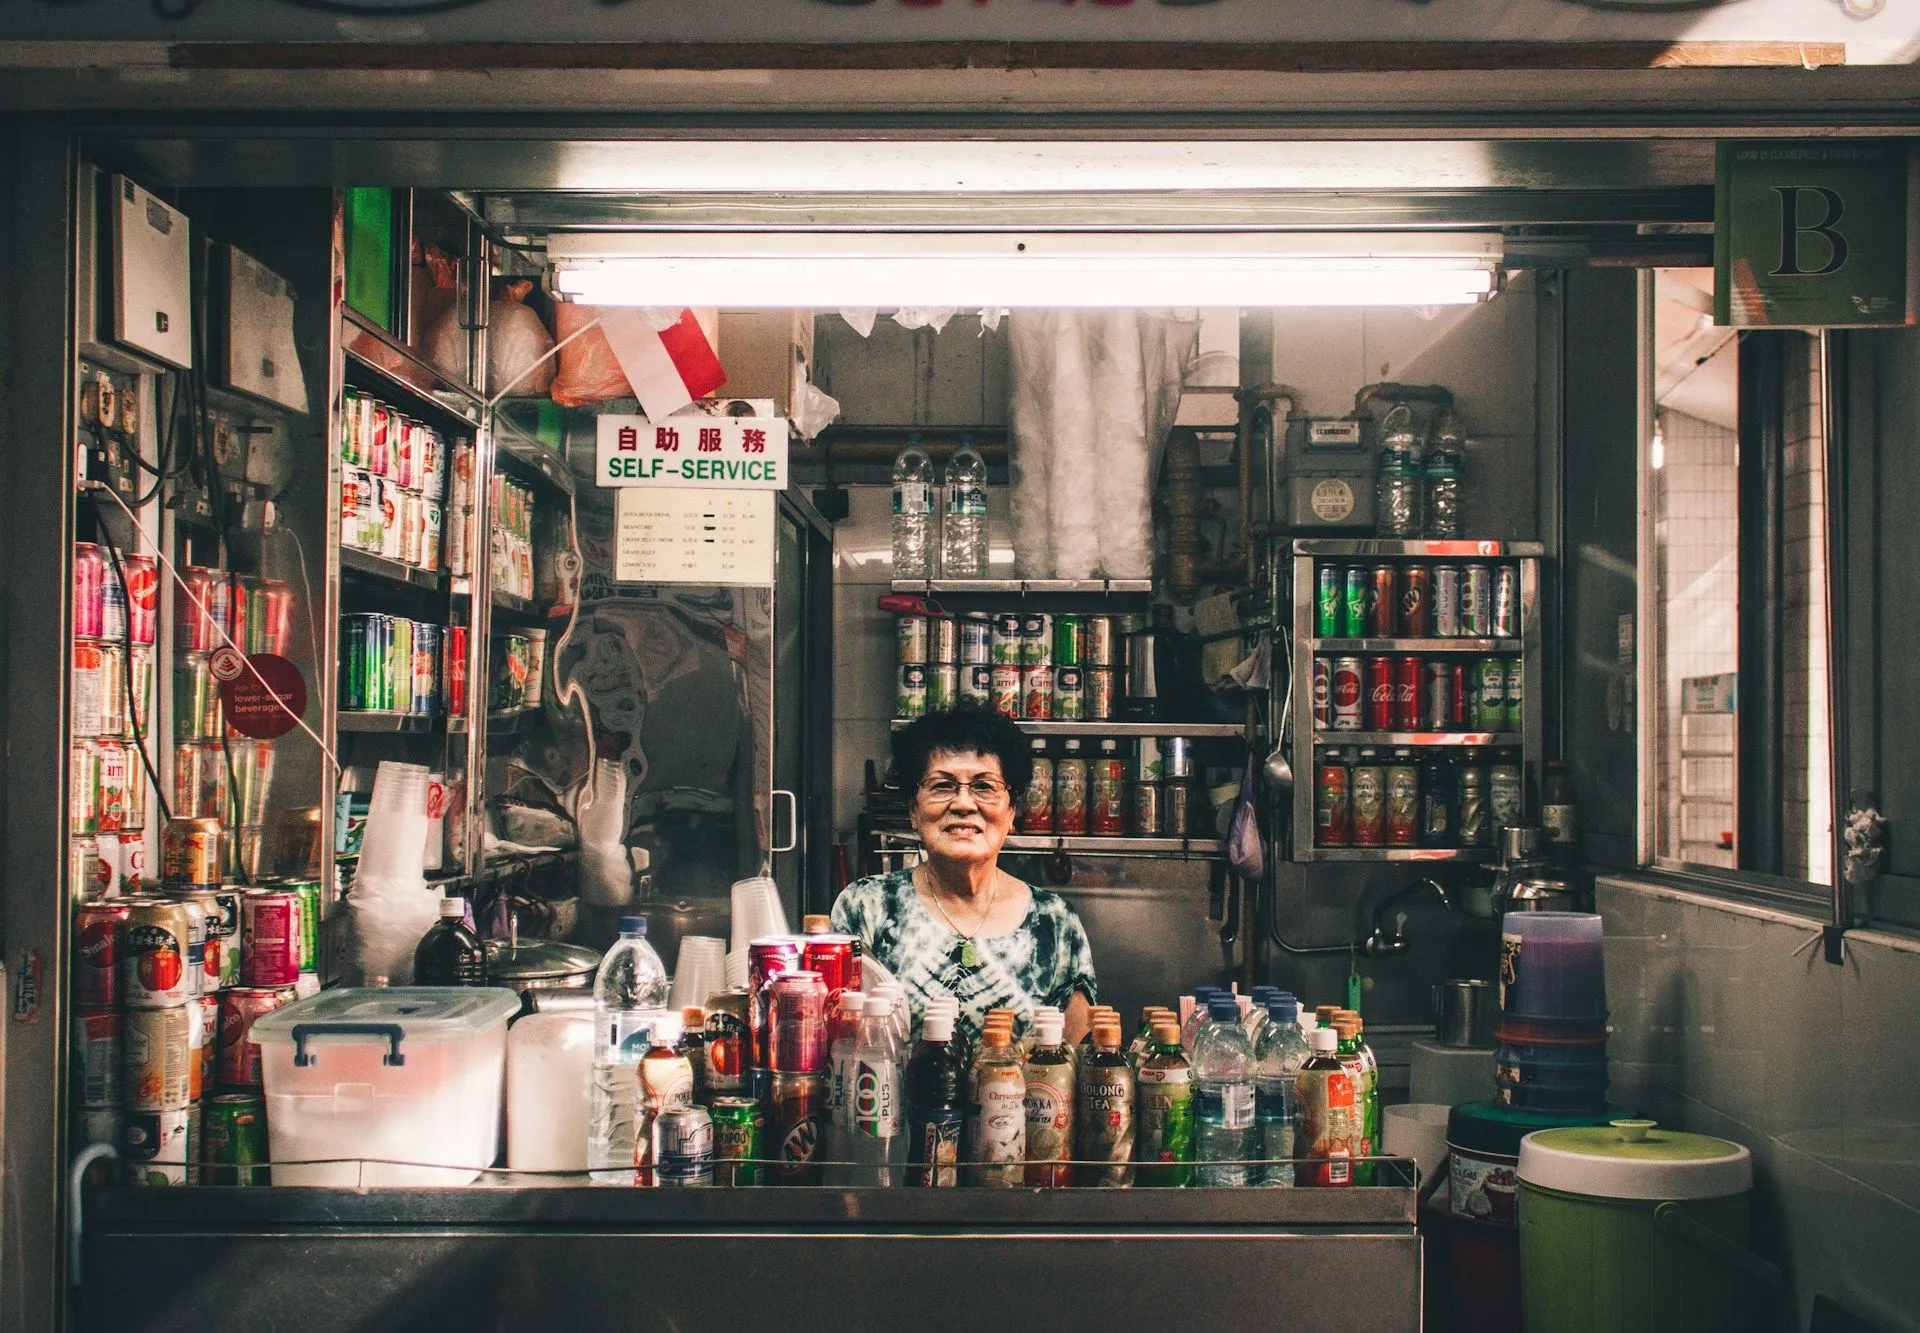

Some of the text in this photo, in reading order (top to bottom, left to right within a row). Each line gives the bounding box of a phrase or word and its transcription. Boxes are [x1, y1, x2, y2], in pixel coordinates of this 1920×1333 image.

[1768, 185, 1850, 277] B
[617, 425, 767, 454] 自助服務
[608, 457, 777, 481] SELF-SERVICE
[854, 1072, 881, 1122] 100
[881, 1083, 890, 1117] PLUS
[1081, 1082, 1124, 1098] OOLONG
[1088, 1097, 1111, 1111] TEA
